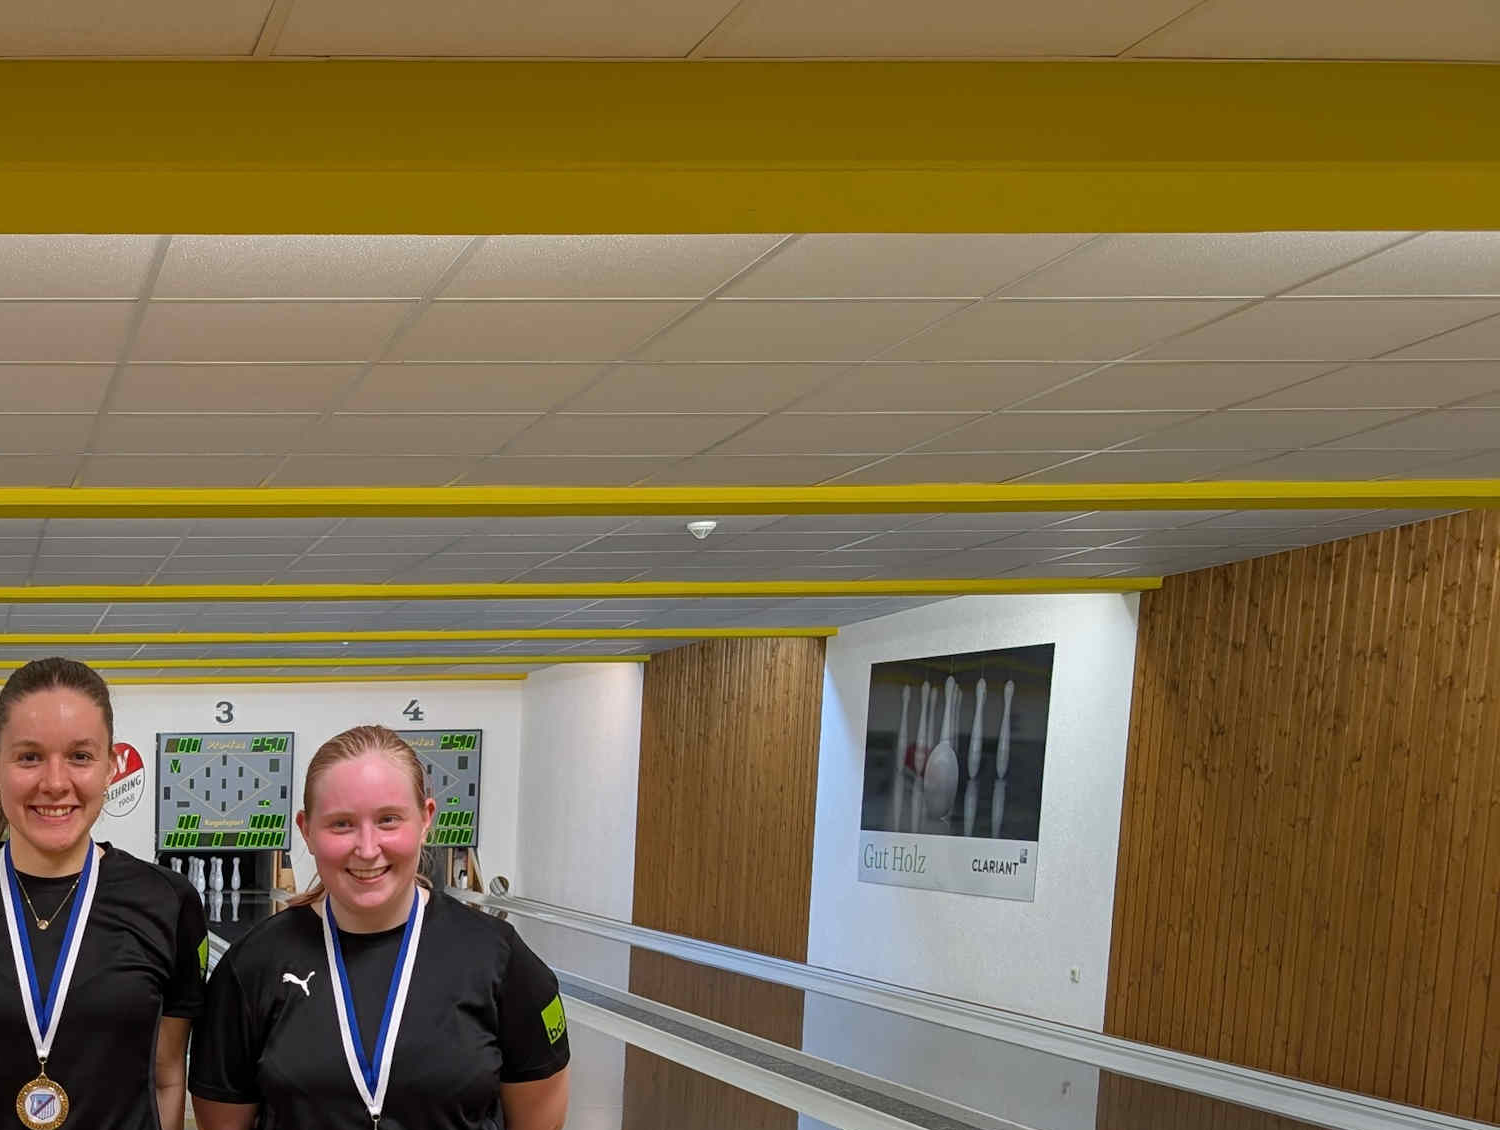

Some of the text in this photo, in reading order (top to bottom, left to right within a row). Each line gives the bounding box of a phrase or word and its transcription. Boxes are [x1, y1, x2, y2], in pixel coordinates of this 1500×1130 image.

[215, 701, 234, 724] 3
[402, 699, 424, 722] 4
[863, 843, 926, 874] Gut Holz
[971, 858, 1020, 876] CLARIANT
